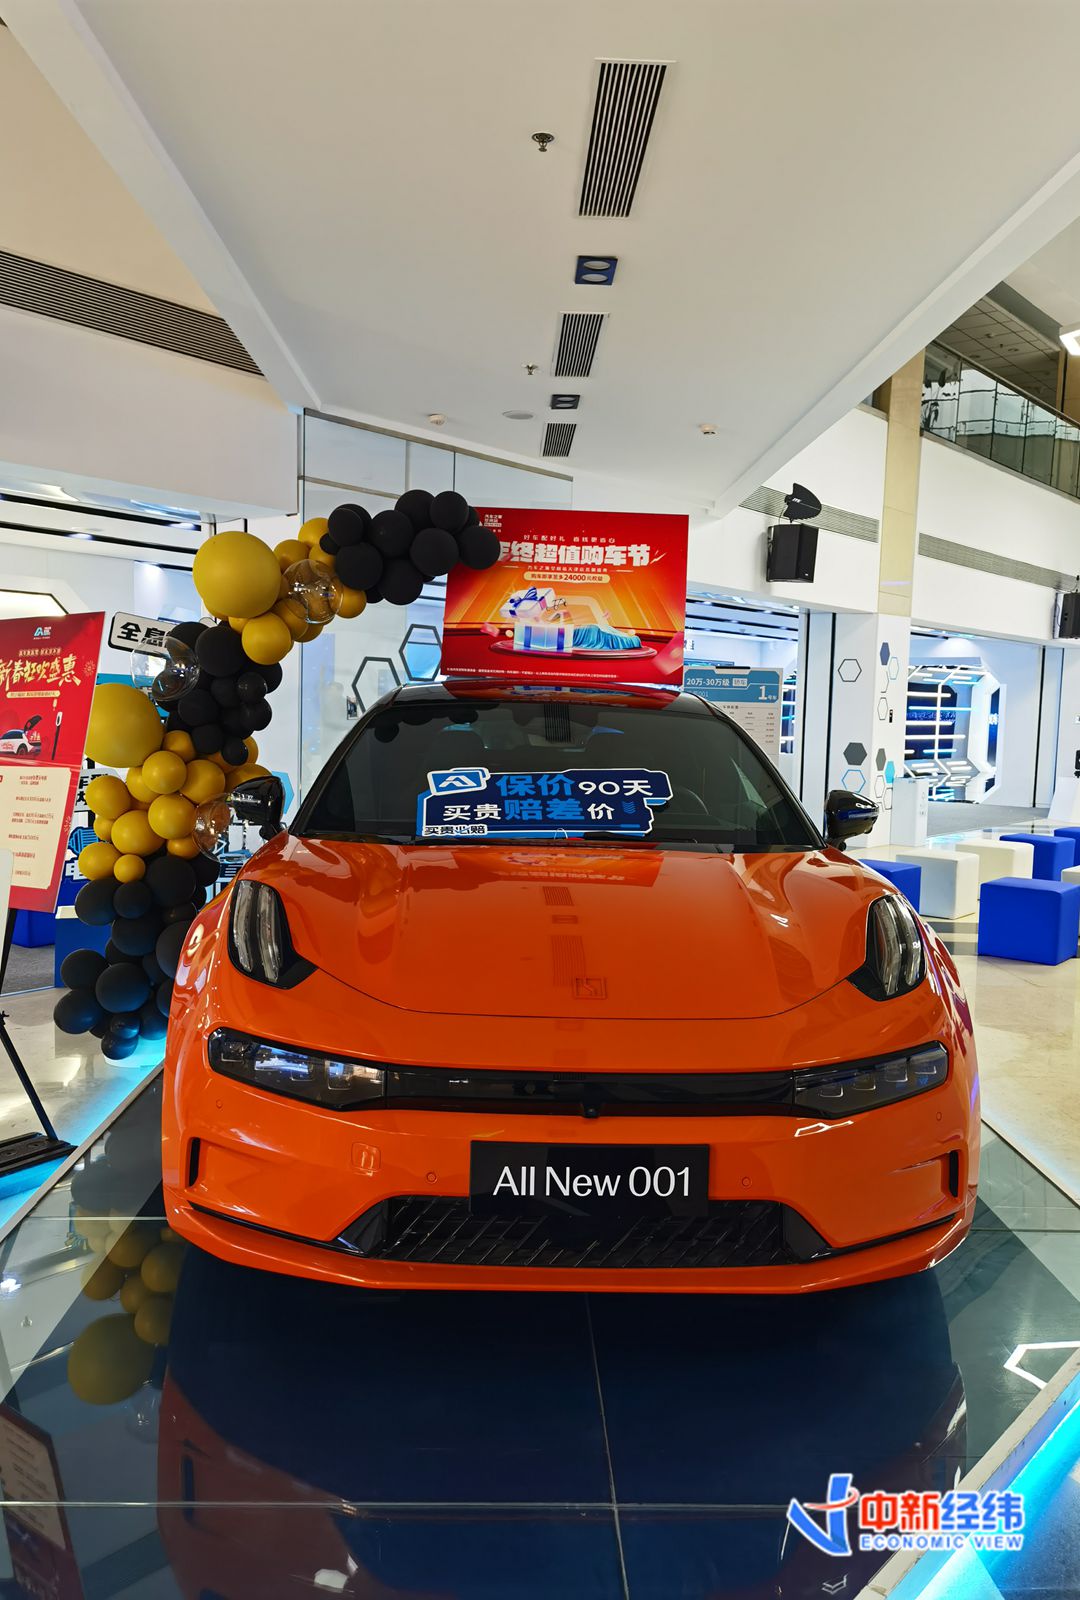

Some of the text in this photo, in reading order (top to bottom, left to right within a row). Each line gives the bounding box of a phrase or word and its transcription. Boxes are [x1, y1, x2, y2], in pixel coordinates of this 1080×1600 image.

[495, 774, 654, 797] 保价90天
[442, 799, 615, 821] 买贵赔差价
[493, 1166, 690, 1197] All New 001
